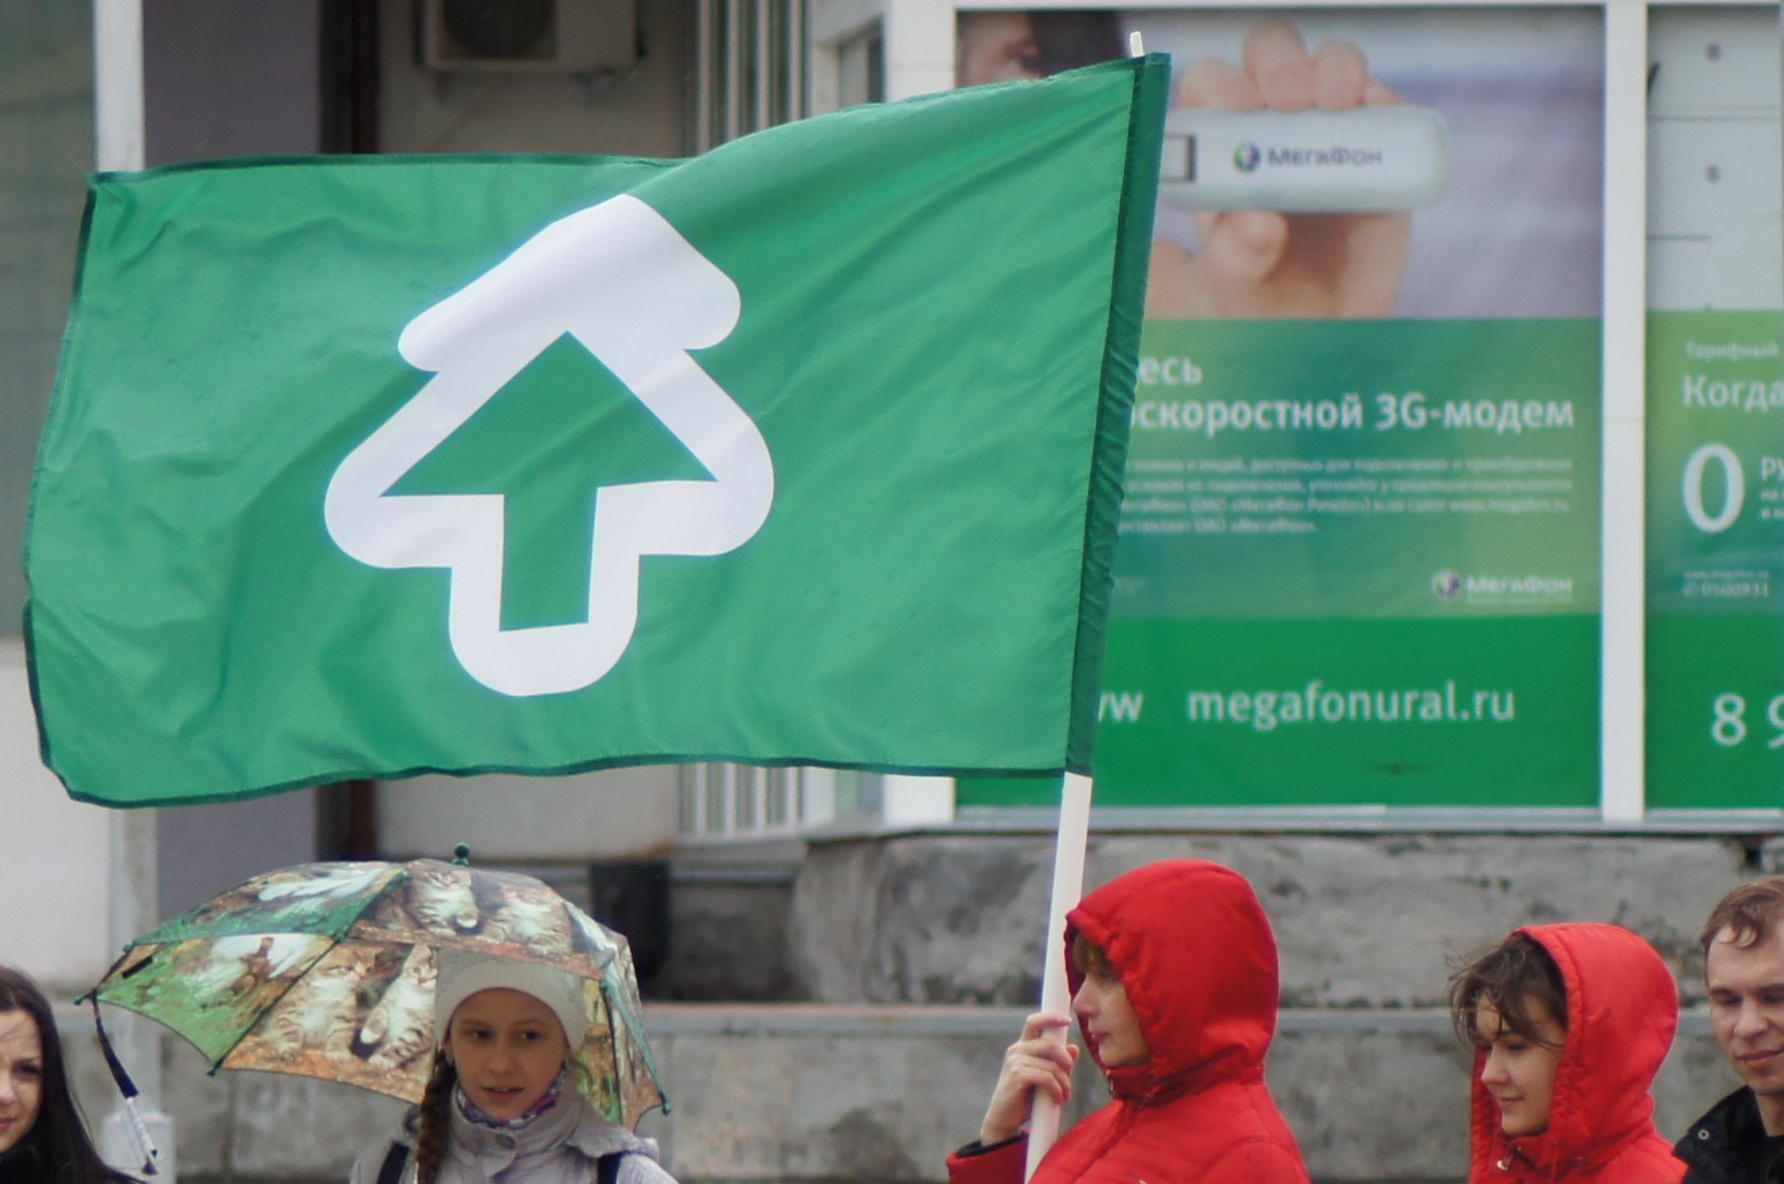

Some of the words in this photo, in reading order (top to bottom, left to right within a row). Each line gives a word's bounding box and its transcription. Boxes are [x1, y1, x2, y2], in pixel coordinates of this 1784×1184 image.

[1137, 356, 1203, 385] есь
[1374, 392, 1576, 433] 3G-модем
[1682, 442, 1746, 534] 0
[1187, 680, 1517, 733] megafonural.ru
[1711, 692, 1748, 747] 8
